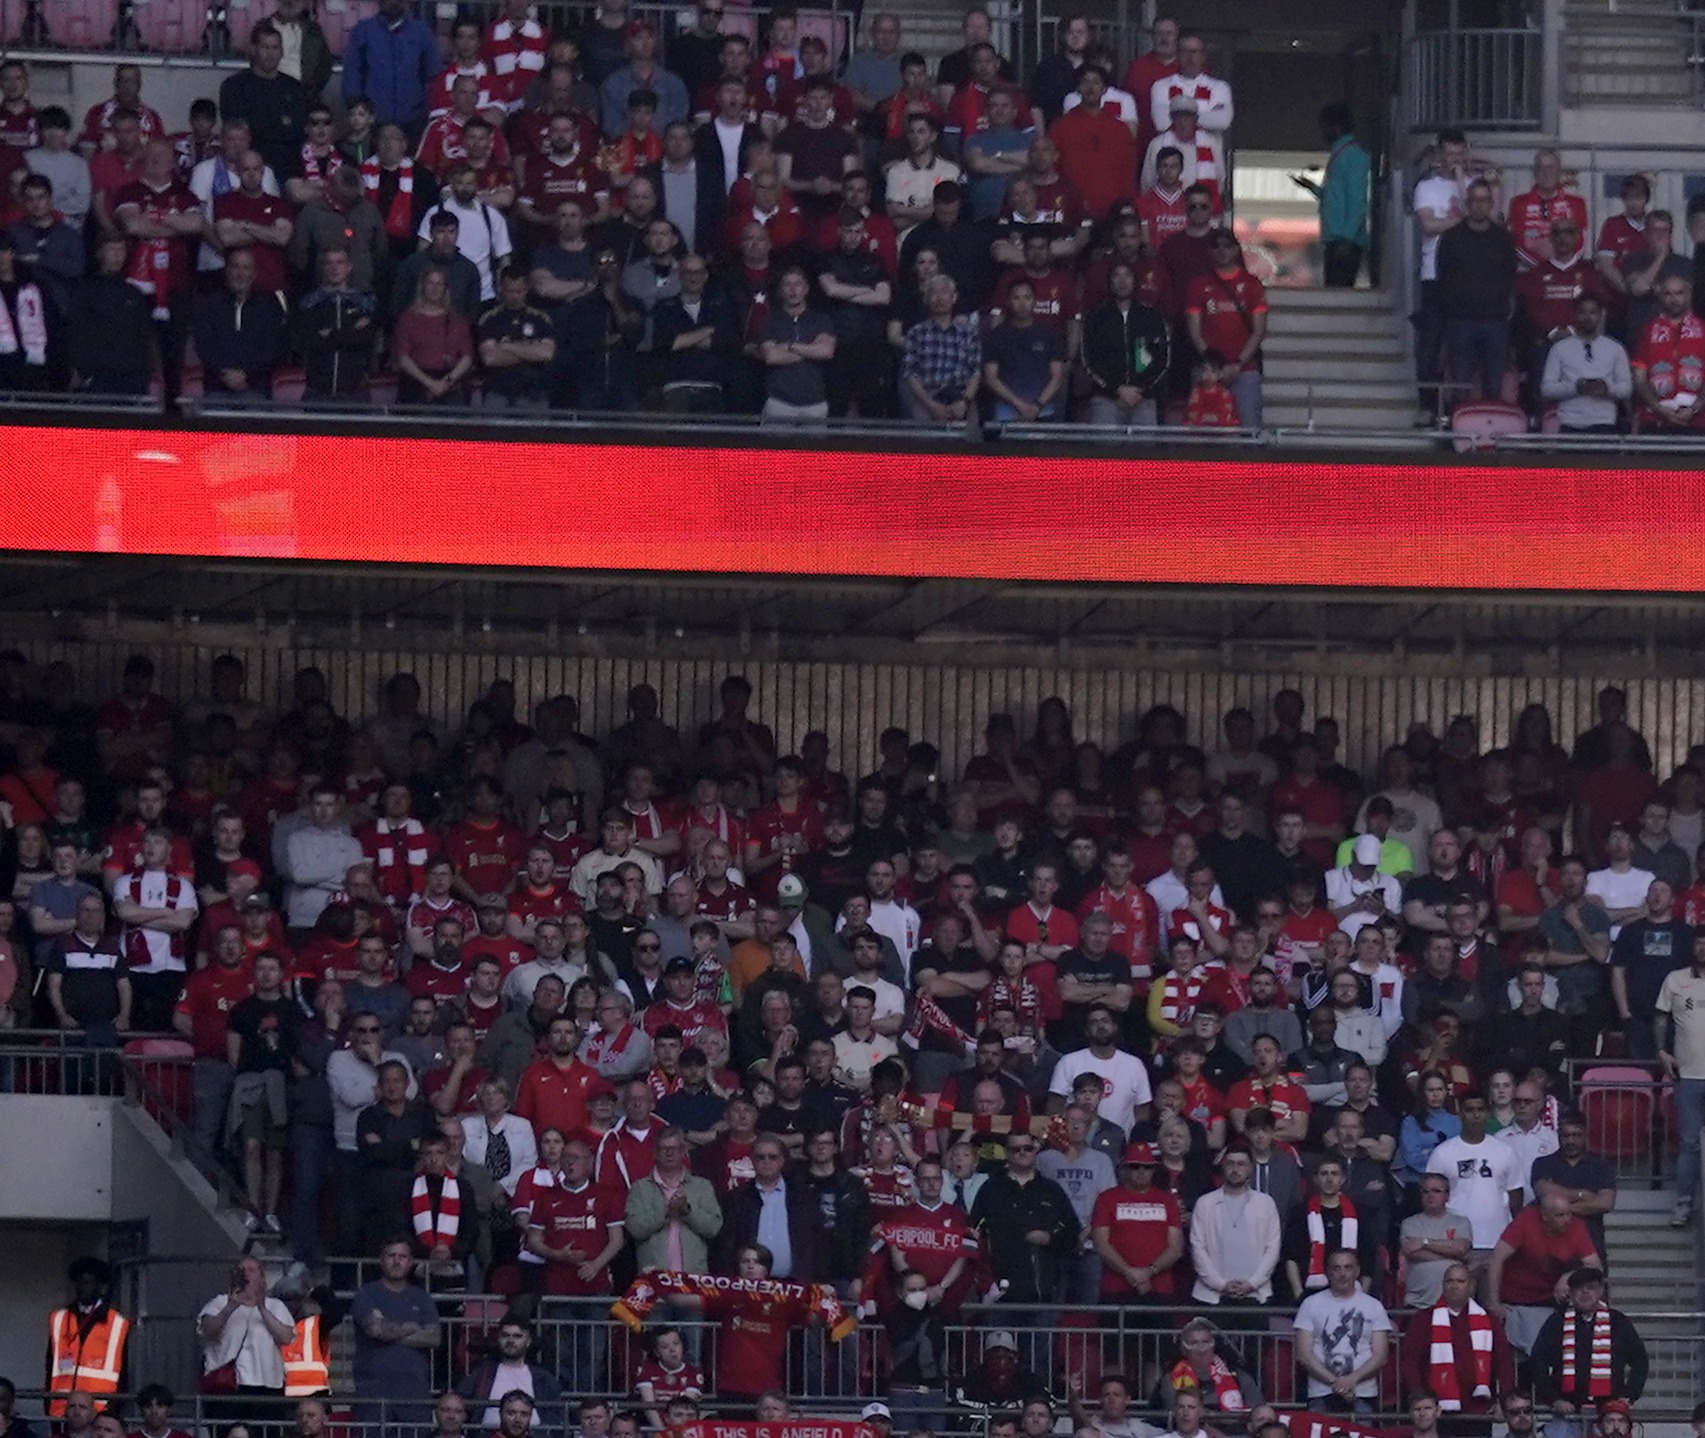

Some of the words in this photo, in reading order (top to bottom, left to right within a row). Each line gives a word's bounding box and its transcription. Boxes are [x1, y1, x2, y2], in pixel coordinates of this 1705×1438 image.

[1057, 1168, 1092, 1179] NYPD
[943, 1234, 961, 1249] FC
[657, 1273, 687, 1288] FC
[688, 1277, 805, 1300] LIVERPOOL
